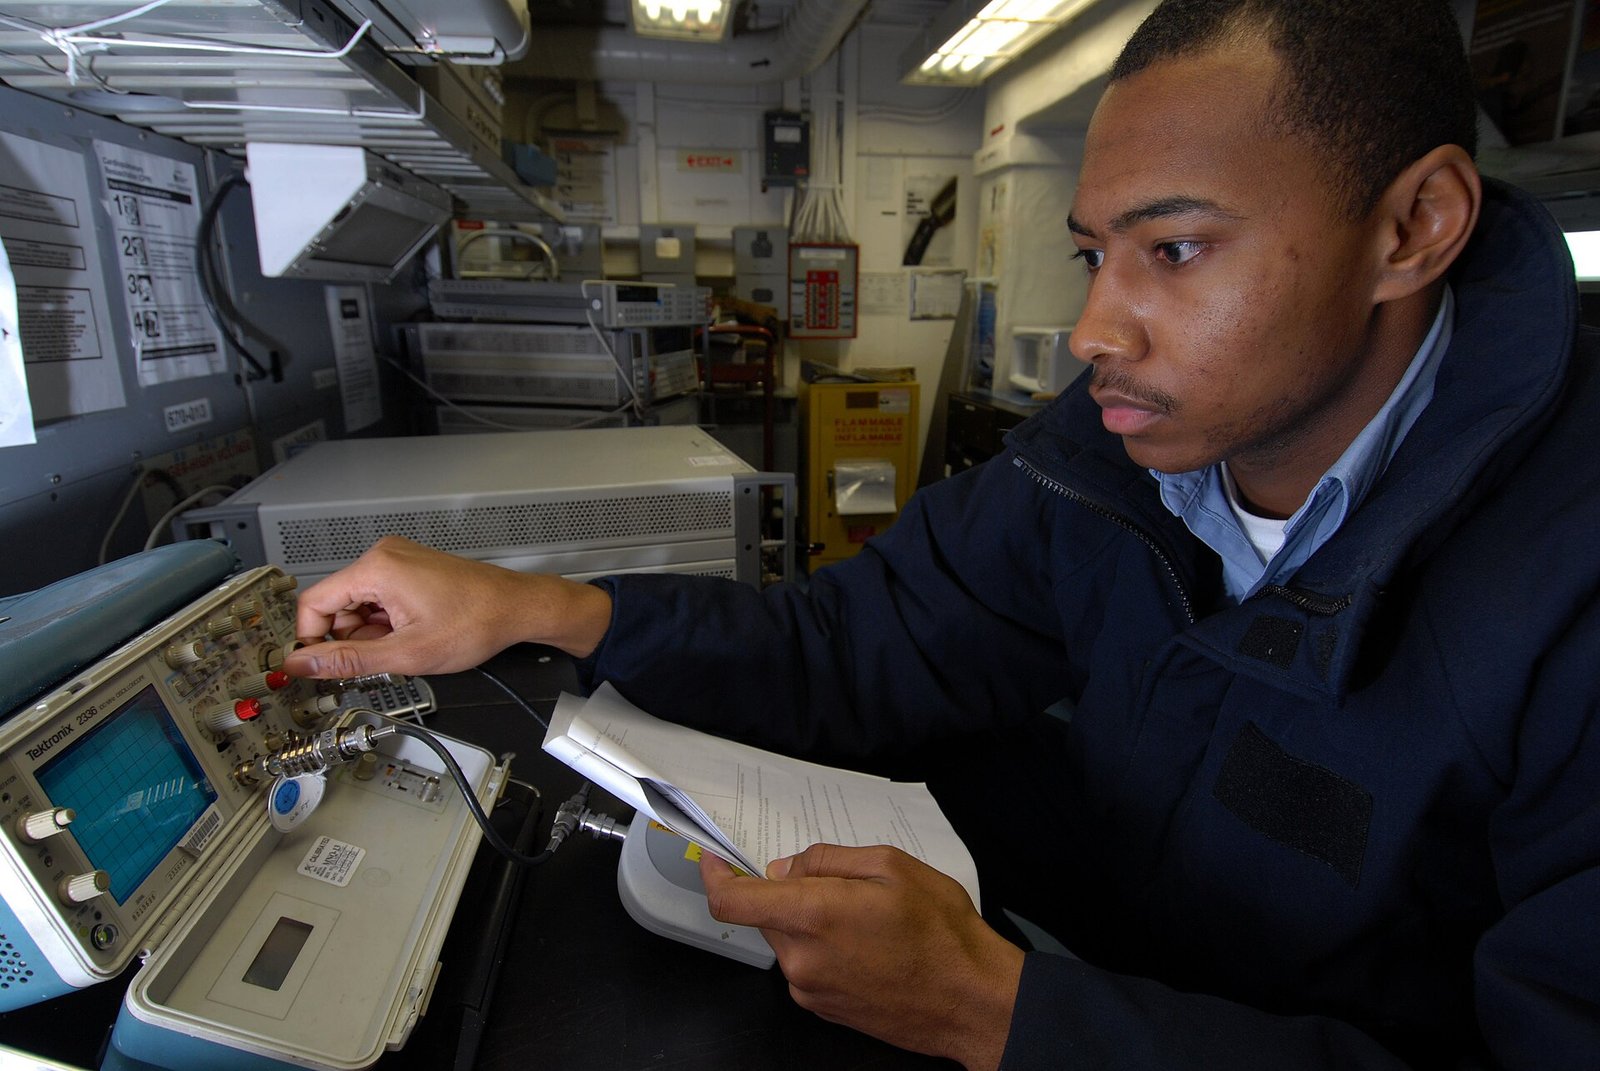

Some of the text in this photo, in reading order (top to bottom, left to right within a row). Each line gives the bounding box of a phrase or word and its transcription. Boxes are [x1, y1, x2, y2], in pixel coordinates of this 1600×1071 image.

[696, 156, 721, 168] EXIT
[113, 194, 123, 216] 1
[121, 235, 133, 257] 2
[127, 273, 137, 294] 3
[134, 311, 143, 332] 4
[834, 416, 904, 427] FLAMMABLE
[25, 723, 75, 761] Tektronix
[76, 705, 98, 726] 2336
[309, 837, 331, 863] CALIBRATED
